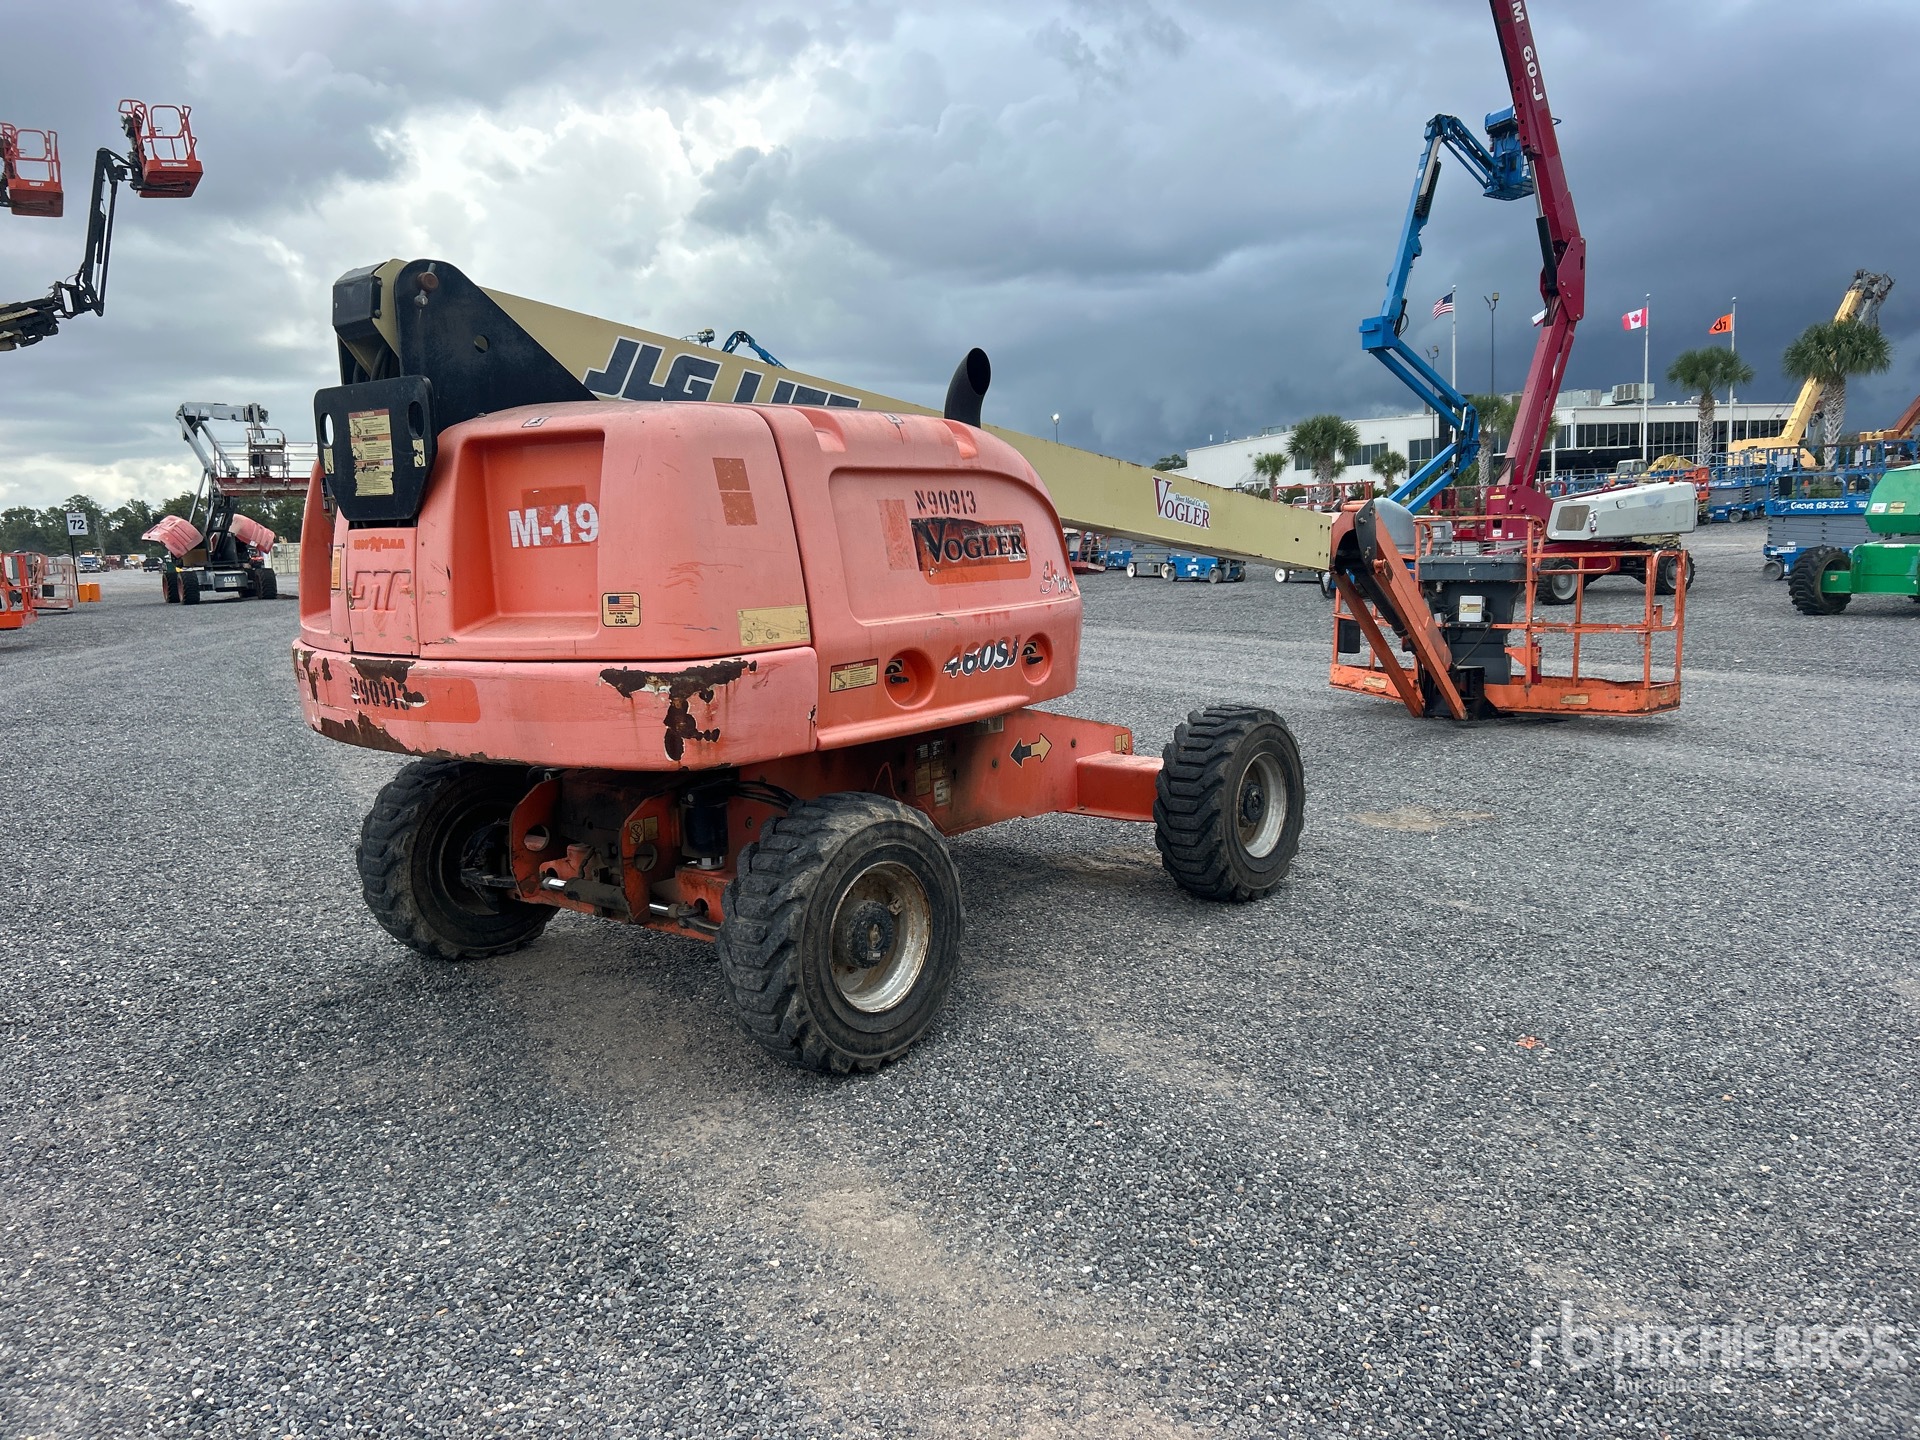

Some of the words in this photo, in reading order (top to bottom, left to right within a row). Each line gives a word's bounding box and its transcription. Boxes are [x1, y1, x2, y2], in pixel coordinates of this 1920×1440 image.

[1523, 45, 1543, 101] 60-J
[583, 336, 723, 402] JLG
[69, 519, 85, 530] 72
[508, 502, 599, 548] M-19
[914, 489, 977, 515] N90913
[1152, 476, 1211, 529] VOGLER
[910, 518, 1026, 563] VOGLER
